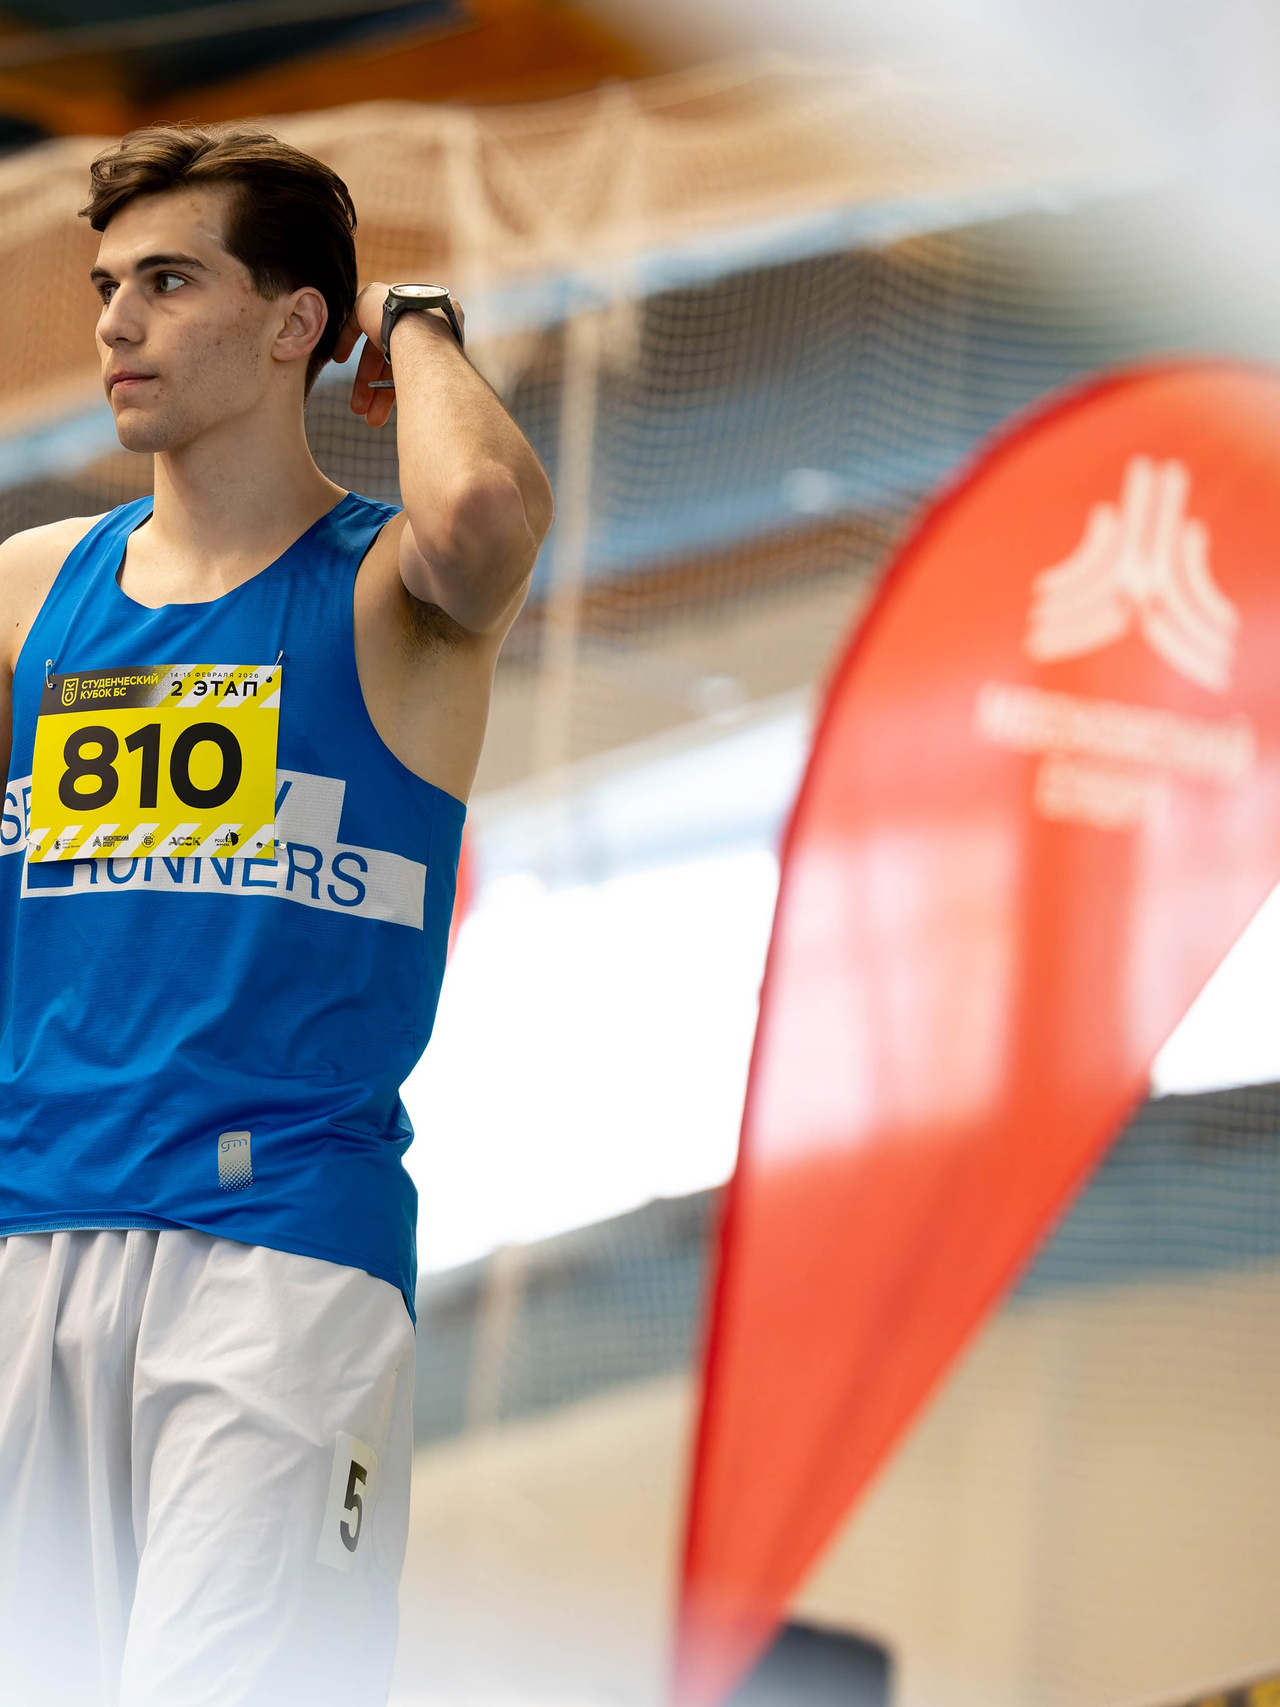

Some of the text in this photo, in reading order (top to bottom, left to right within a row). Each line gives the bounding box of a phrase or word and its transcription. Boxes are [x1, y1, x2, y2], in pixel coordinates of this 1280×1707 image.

[81, 673, 159, 690] СТУДЕНЧЕСКИЙ
[170, 680, 258, 697] 2 ЭТАП
[80, 687, 127, 700] КУБОК БС
[58, 722, 243, 811] 810
[339, 1459, 368, 1553] 5
